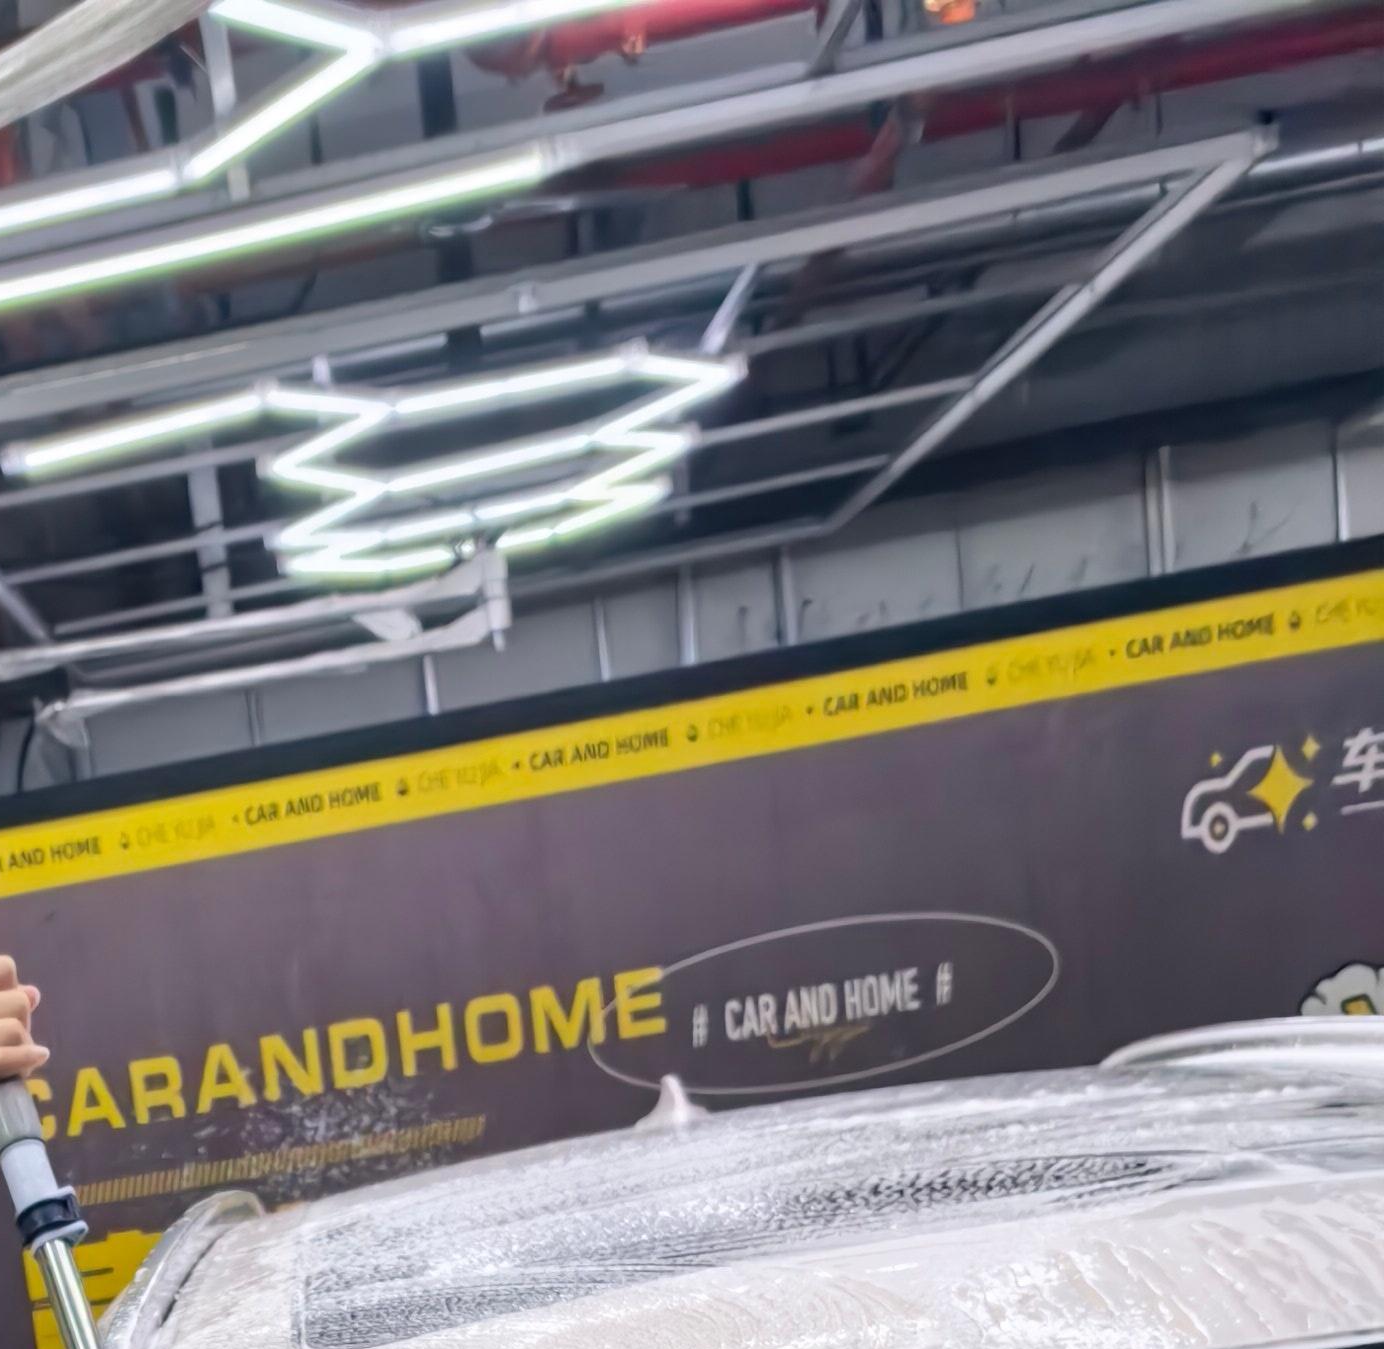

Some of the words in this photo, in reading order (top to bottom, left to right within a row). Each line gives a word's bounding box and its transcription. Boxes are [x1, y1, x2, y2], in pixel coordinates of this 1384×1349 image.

[1126, 635, 1164, 659] CAR
[1170, 624, 1214, 649] AND
[1218, 613, 1276, 642] HOME
[822, 695, 859, 717] CAR
[866, 683, 906, 707] AND
[912, 671, 968, 699] HOME
[529, 748, 565, 772] CAR
[570, 740, 610, 764] AND
[616, 726, 669, 755] HOME
[244, 804, 280, 827] CAR
[285, 793, 324, 817] AND
[328, 781, 383, 810] HOME
[8, 846, 46, 870] AND
[50, 835, 103, 864] HOME
[724, 993, 778, 1041] CAR
[784, 983, 838, 1035] AND
[843, 967, 921, 1021] HOME
